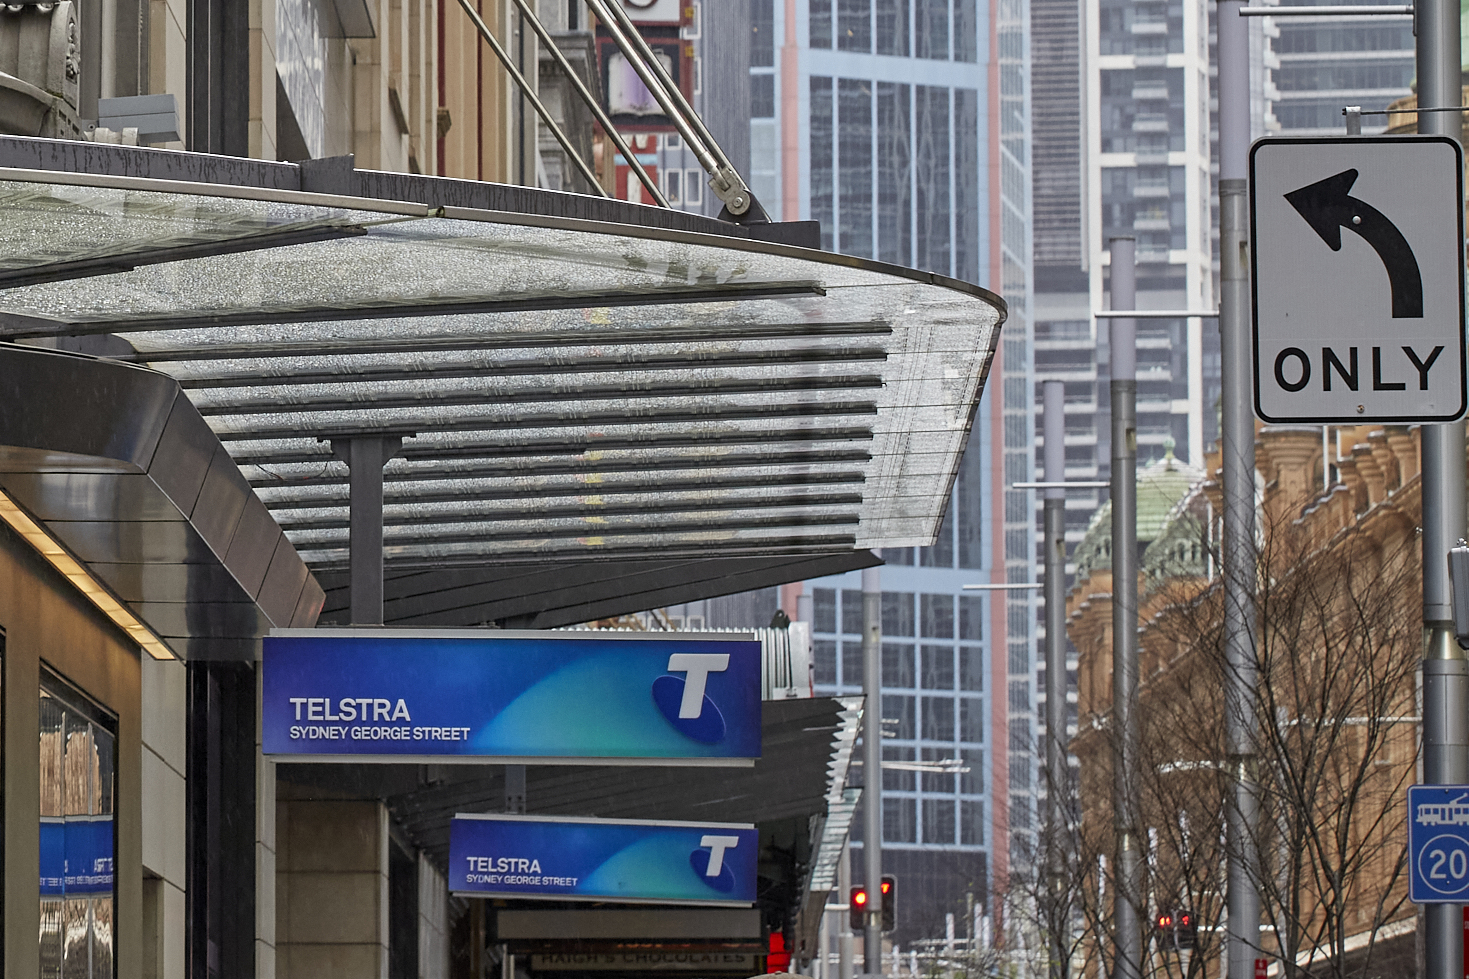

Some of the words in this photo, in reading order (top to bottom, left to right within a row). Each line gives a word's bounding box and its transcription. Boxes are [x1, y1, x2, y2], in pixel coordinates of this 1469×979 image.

[1274, 346, 1445, 392] ONLY
[667, 653, 730, 719] T
[289, 698, 411, 722] TELSTRA
[289, 725, 348, 740] SYDNEY
[351, 726, 410, 741] GEORGE
[412, 727, 471, 741] STREET
[466, 856, 542, 874] TELSTRA
[700, 835, 739, 877] T
[1429, 849, 1467, 879] 20
[466, 874, 503, 884] SYDNEY
[504, 875, 541, 885] GEORGE
[542, 876, 578, 886] STREET
